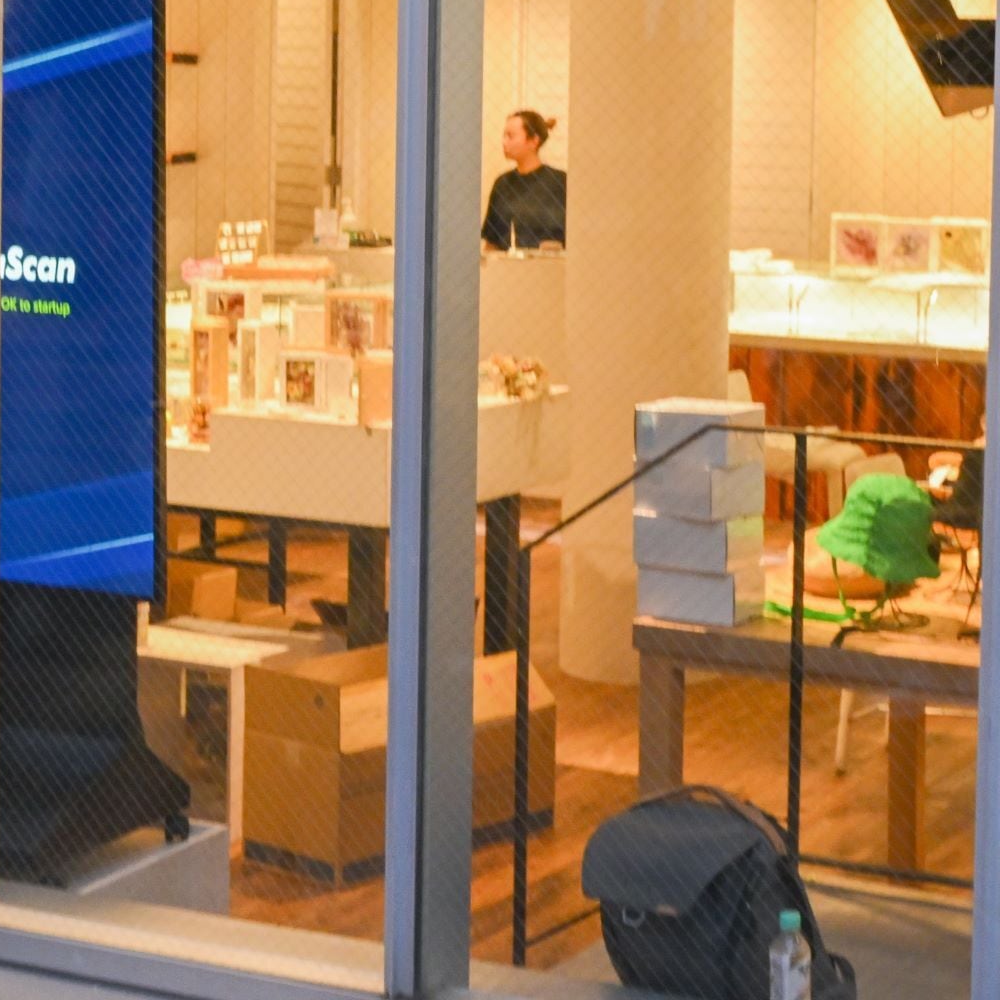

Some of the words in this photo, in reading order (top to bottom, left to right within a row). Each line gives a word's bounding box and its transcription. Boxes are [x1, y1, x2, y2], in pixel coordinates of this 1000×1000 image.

[1, 296, 17, 312] OK
[19, 298, 31, 313] to
[33, 299, 71, 319] startup
